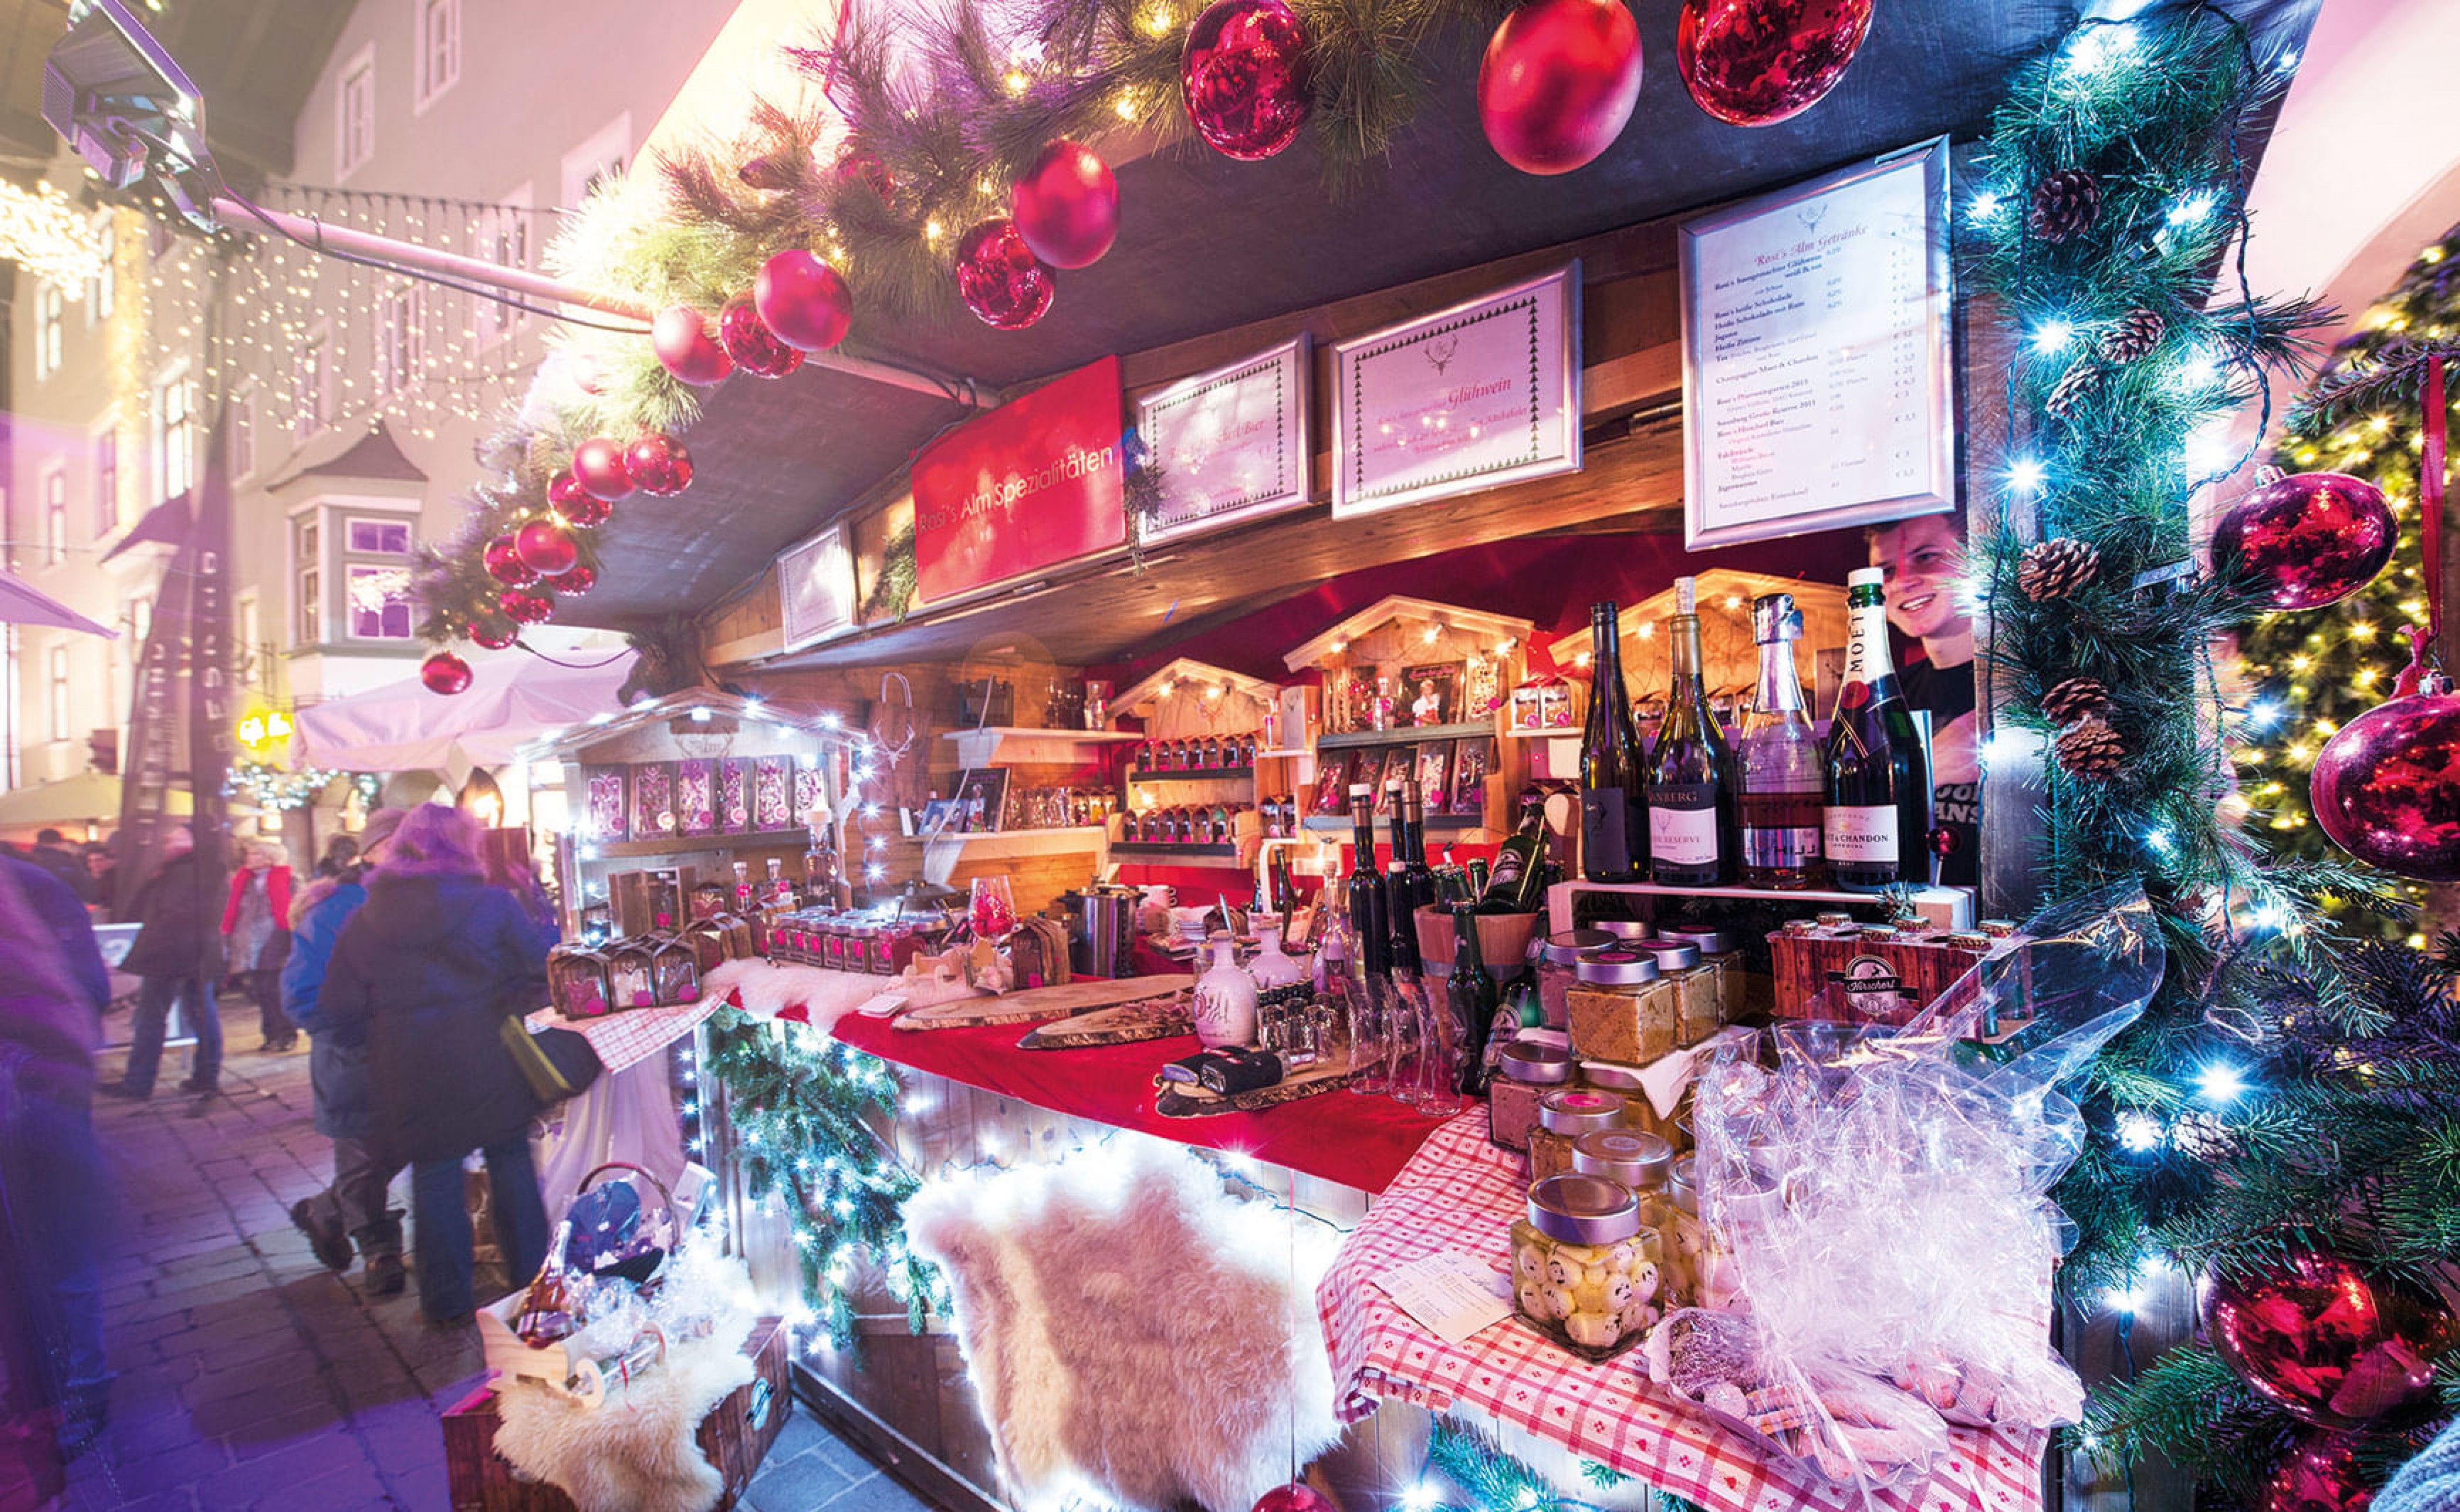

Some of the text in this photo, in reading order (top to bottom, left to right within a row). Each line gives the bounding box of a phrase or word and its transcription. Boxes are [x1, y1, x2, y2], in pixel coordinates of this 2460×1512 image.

[1448, 378, 1512, 411] Glühwein
[961, 491, 991, 519] Alm
[994, 445, 1113, 508] Spezialitäten
[1840, 834, 1888, 843] CHANDON
